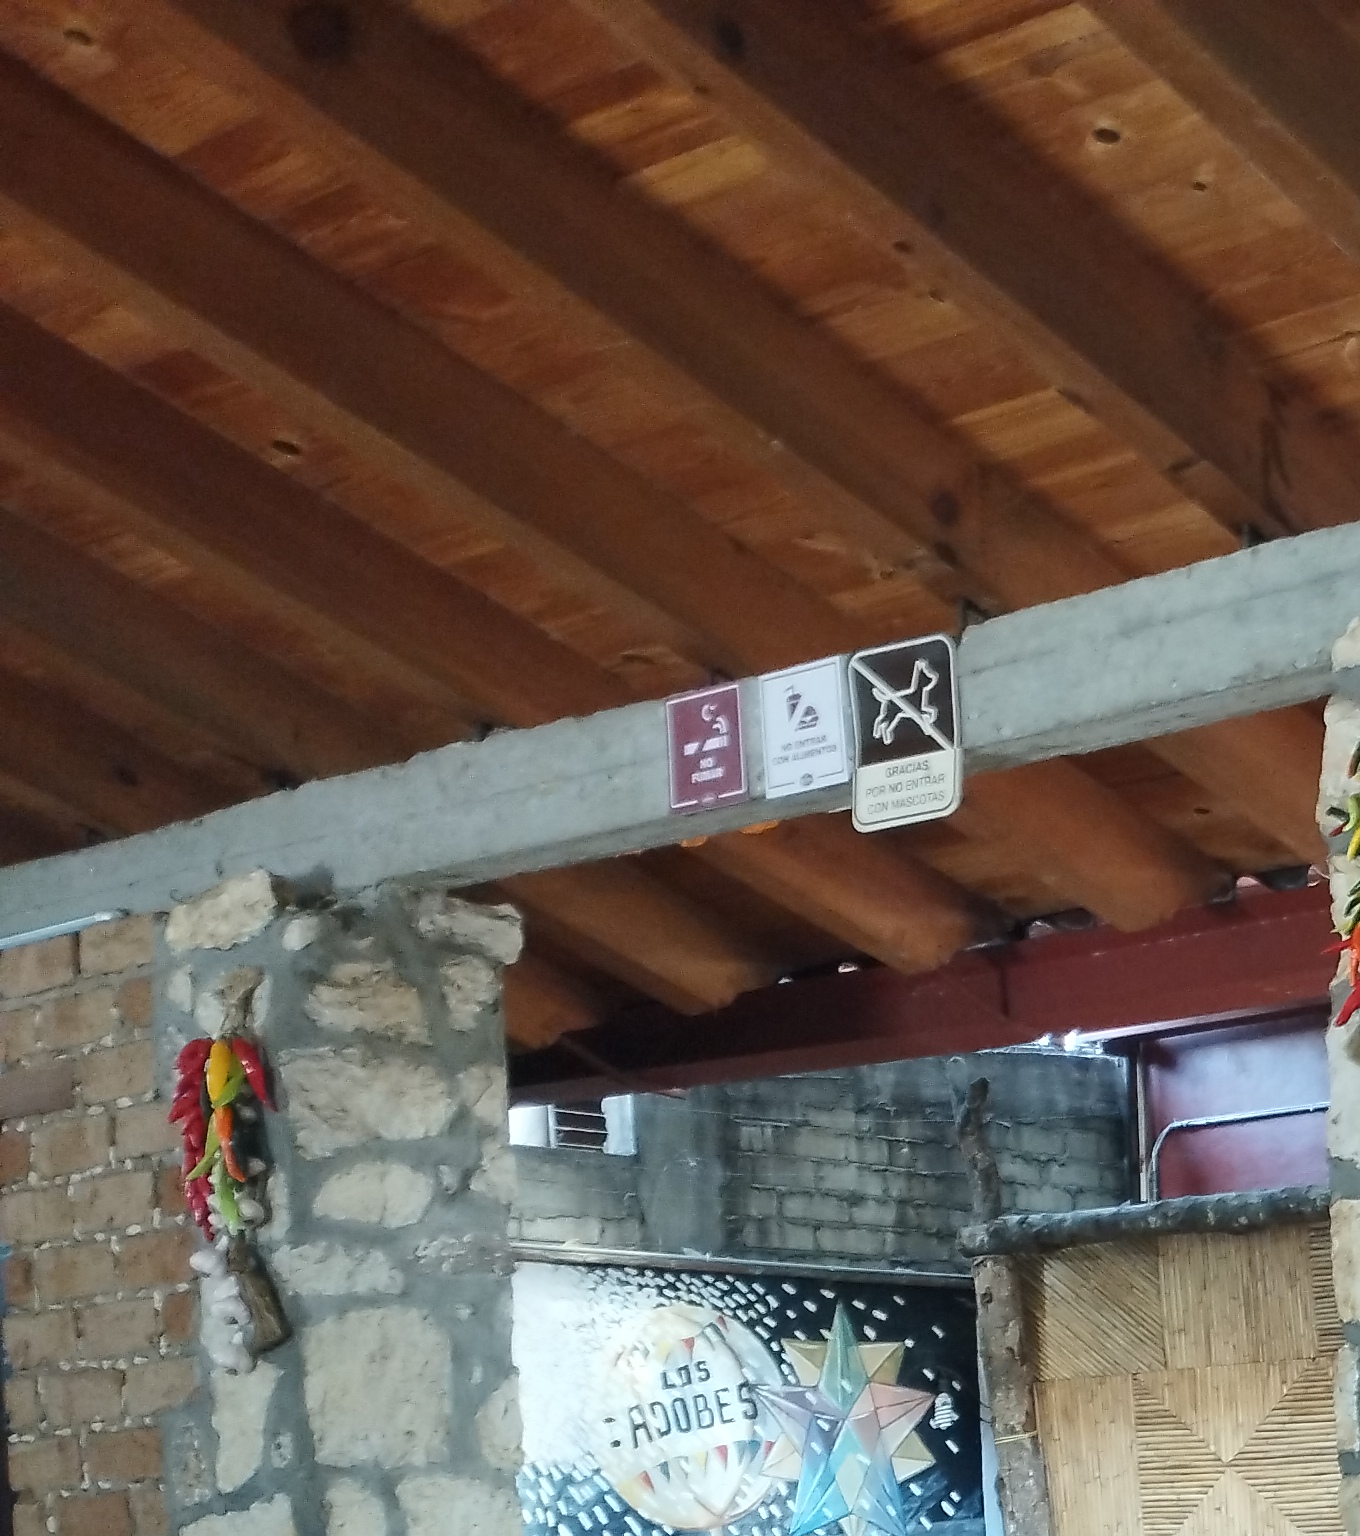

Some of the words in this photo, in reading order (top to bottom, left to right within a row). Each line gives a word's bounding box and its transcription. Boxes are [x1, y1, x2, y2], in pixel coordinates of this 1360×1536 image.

[885, 760, 929, 778] GRACIAS
[866, 785, 885, 798] POR
[889, 781, 902, 792] NO
[906, 773, 944, 790] ENTRAR
[867, 802, 888, 814] CON
[892, 790, 945, 808] MASCOTAS
[660, 1360, 711, 1390] LOS
[627, 1380, 758, 1449] ADOBES
